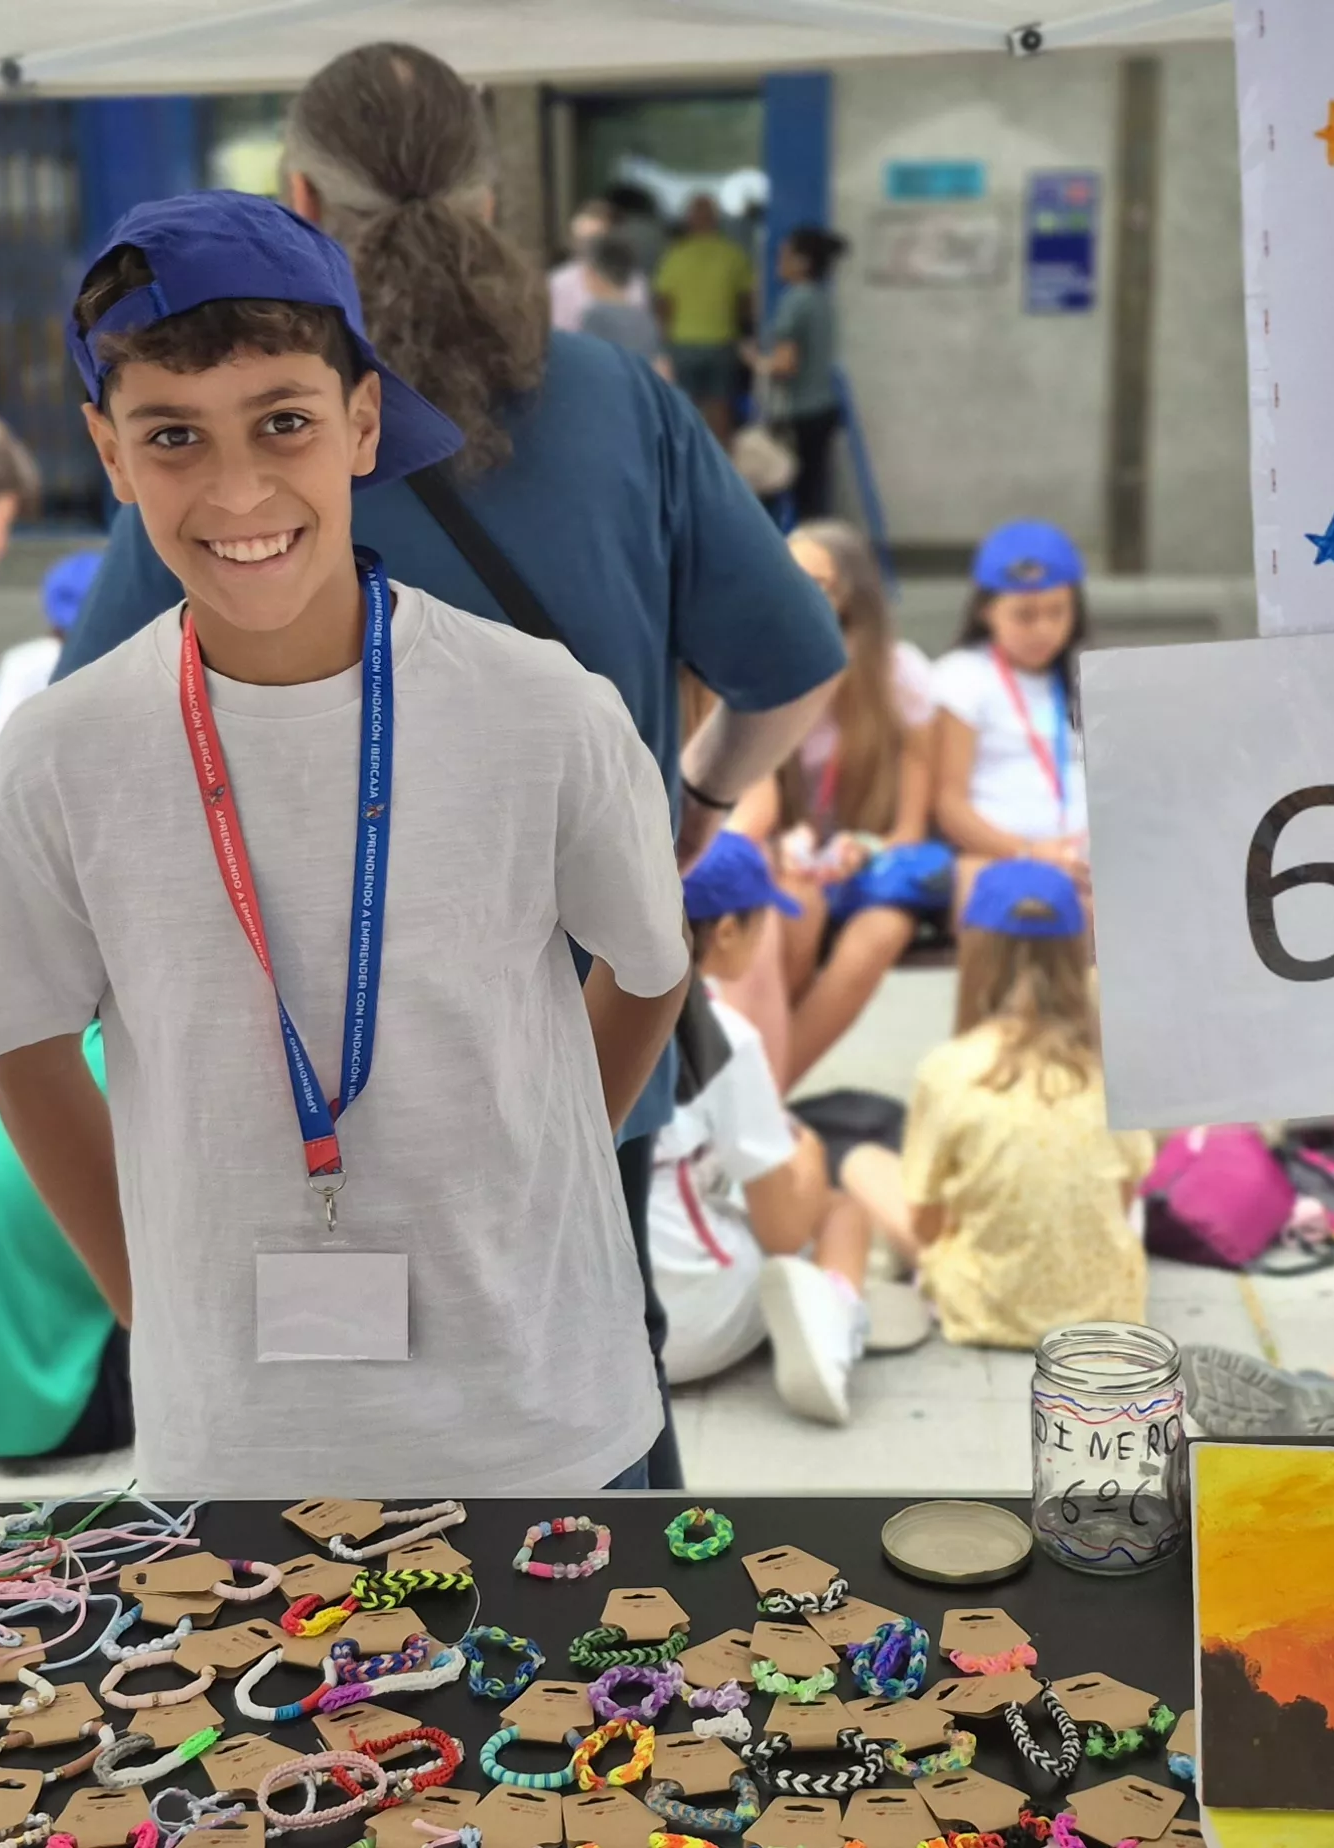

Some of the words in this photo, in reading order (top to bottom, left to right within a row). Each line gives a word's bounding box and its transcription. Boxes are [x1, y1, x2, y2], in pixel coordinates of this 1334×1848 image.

[370, 581, 384, 646] EMPRENDER
[371, 649, 382, 673] CON
[184, 664, 203, 729] FUNDACIÓN
[196, 730, 216, 785] IBERCAJA
[370, 675, 384, 741] FUNDACIÓN
[369, 743, 382, 799] IBERCAJA
[215, 809, 242, 890] APRENDIENDO
[362, 825, 378, 907] APRENDIENDO
[361, 909, 371, 918] A
[357, 921, 372, 990] EMPRENDER
[355, 992, 366, 1016] CON
[289, 1037, 319, 1114] APRENDIENDO
[350, 1018, 364, 1083] FUNDACIÓN
[1034, 1409, 1183, 1461] DINERO
